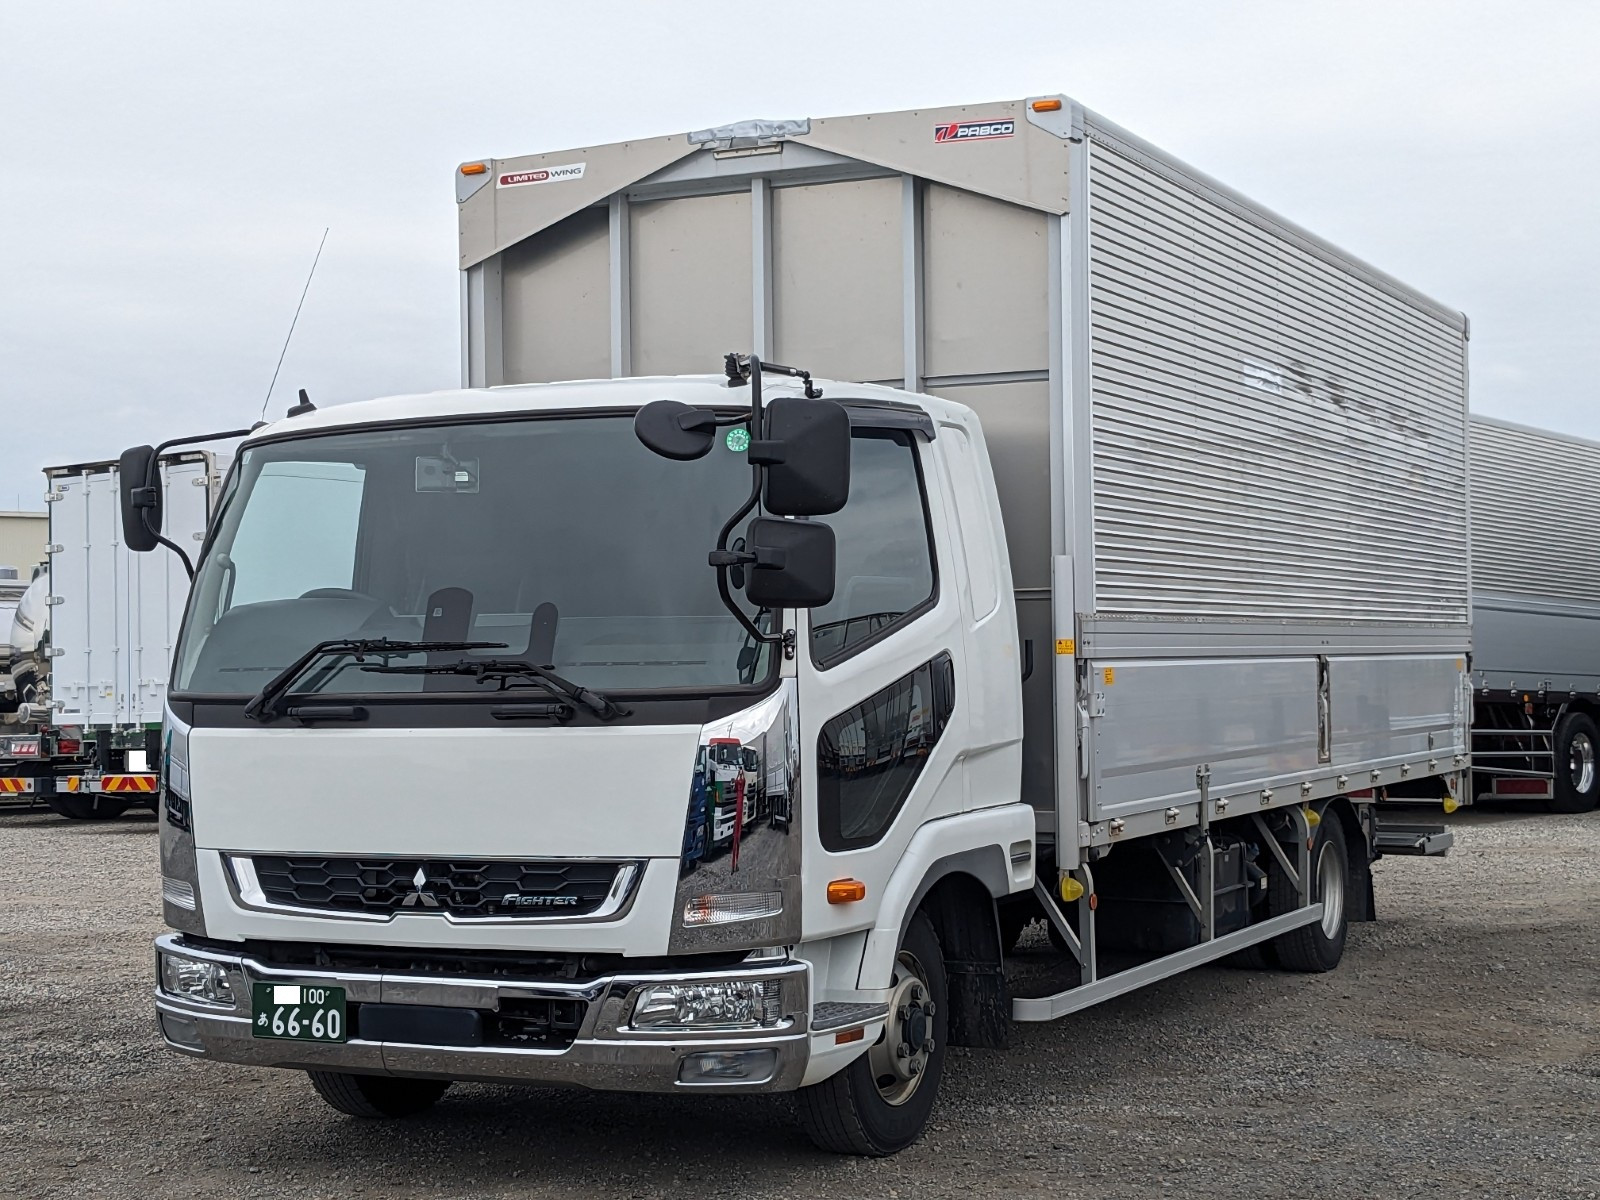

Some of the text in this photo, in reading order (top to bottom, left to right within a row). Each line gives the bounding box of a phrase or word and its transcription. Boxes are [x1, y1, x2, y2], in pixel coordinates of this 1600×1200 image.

[957, 123, 1013, 137] PABCO
[507, 167, 582, 183] LIMITED WING
[501, 893, 578, 906] FIGHTER
[303, 988, 325, 1005] 100
[257, 1005, 341, 1039] あ 66-60
